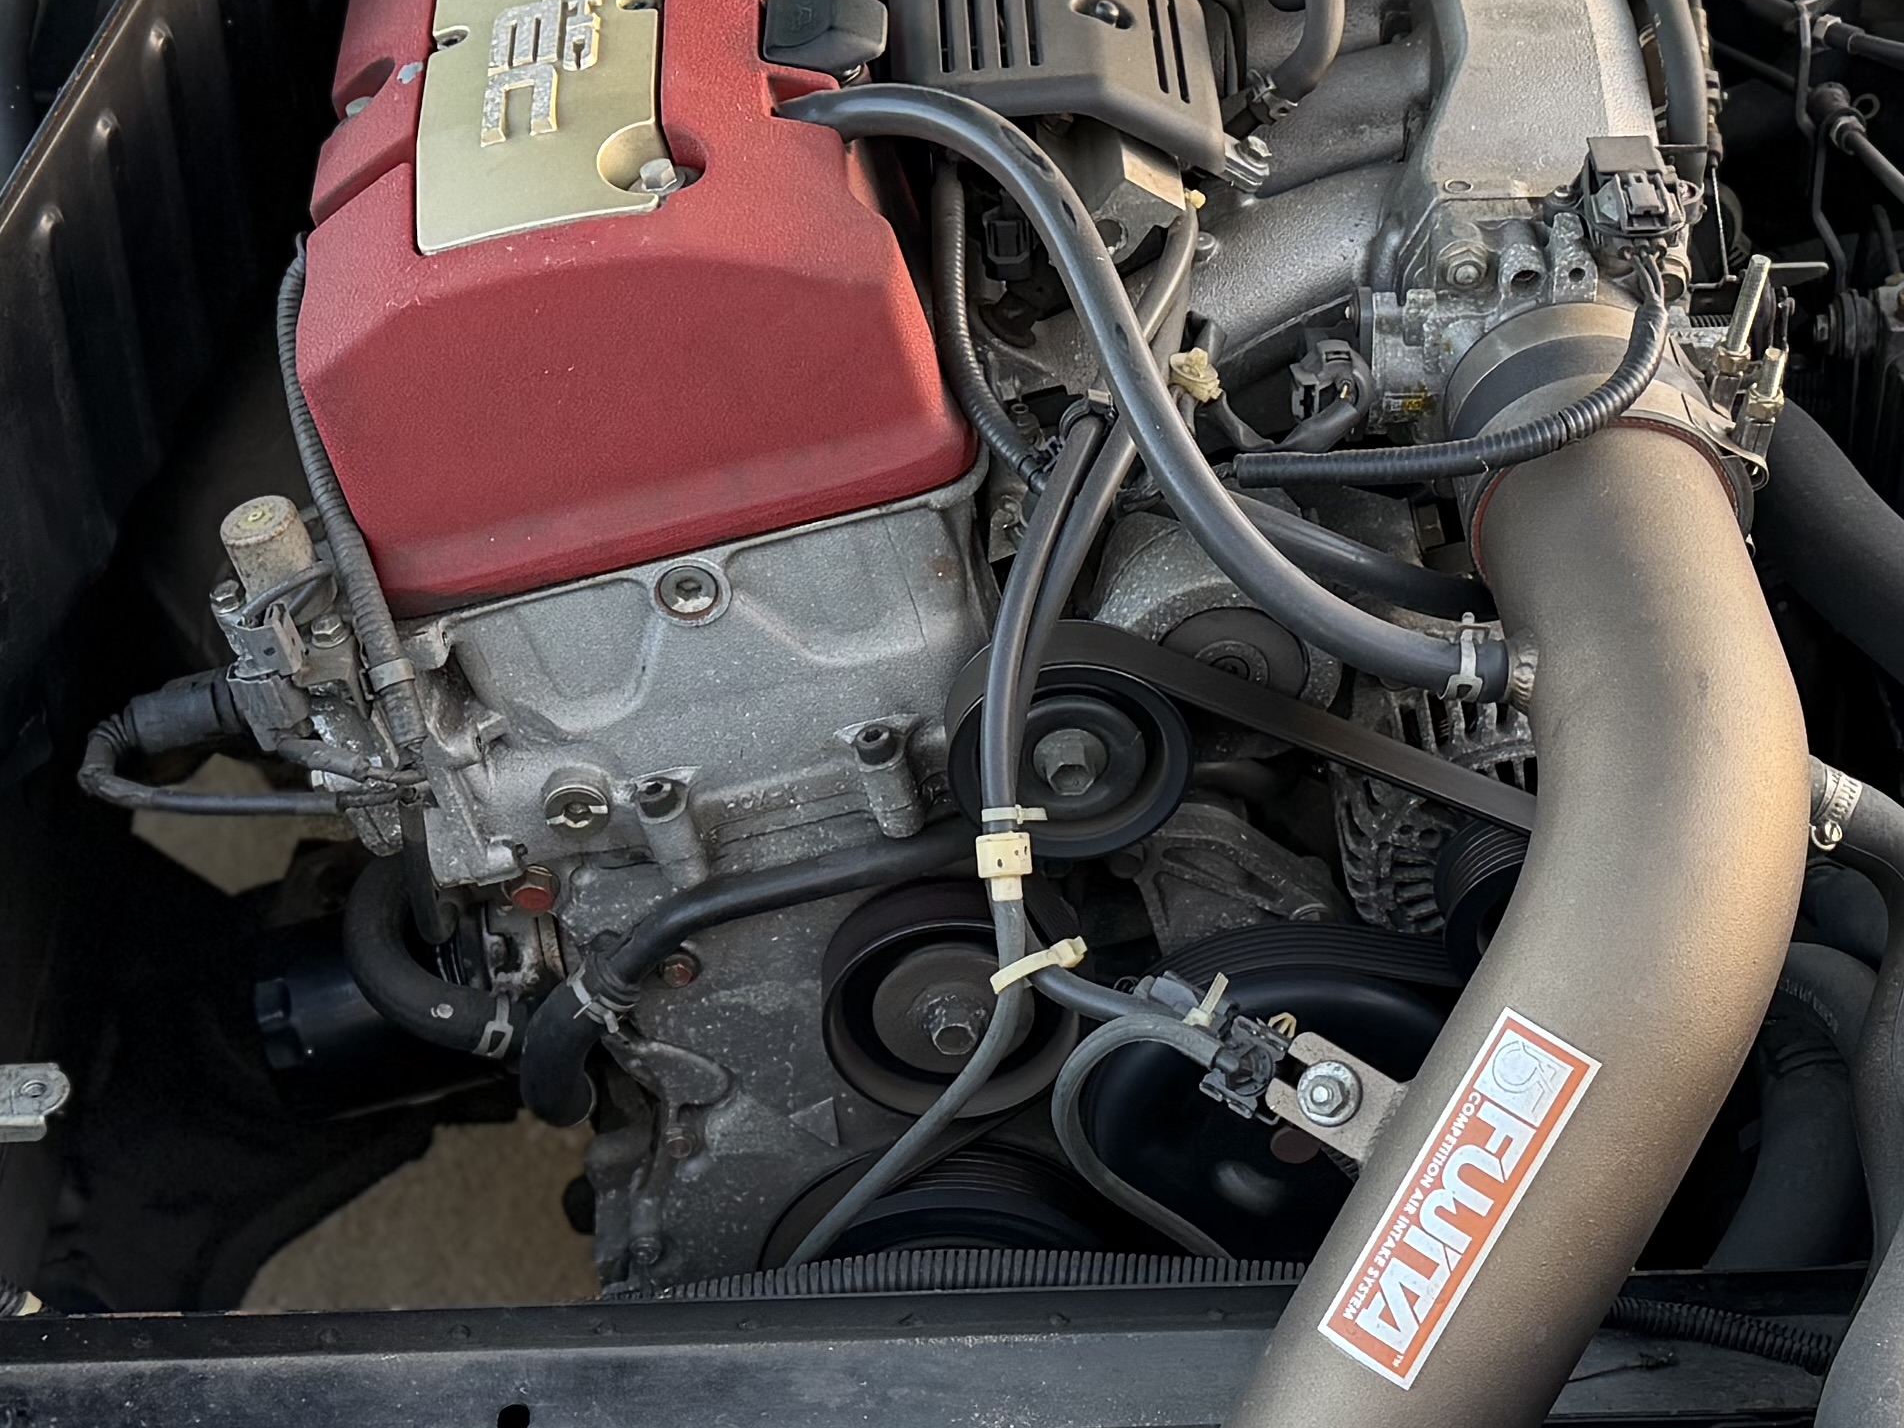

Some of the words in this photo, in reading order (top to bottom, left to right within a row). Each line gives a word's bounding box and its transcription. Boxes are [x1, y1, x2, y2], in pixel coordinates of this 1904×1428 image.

[1417, 1089, 1482, 1188] COMPETITION
[1352, 1099, 1536, 1356] FUJITA
[1402, 1187, 1426, 1216] AIR
[1371, 1213, 1410, 1268] INTAKE
[1340, 1265, 1380, 1321] SYSTEM
